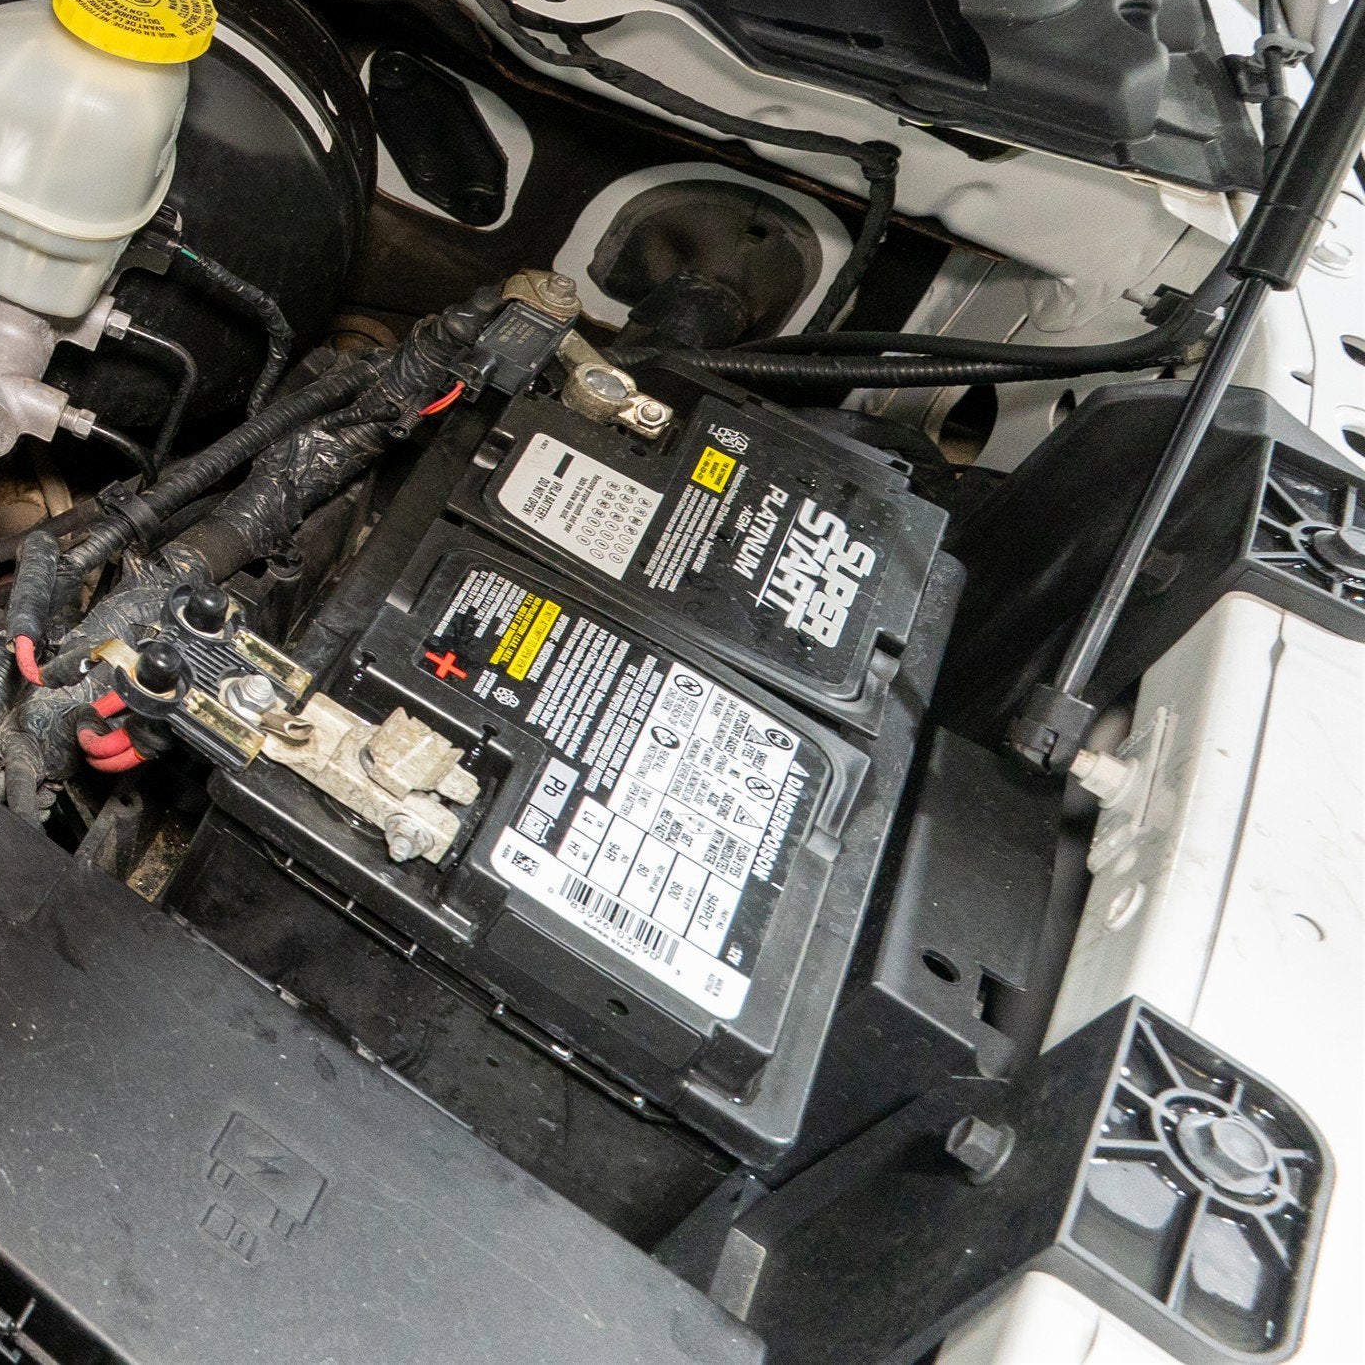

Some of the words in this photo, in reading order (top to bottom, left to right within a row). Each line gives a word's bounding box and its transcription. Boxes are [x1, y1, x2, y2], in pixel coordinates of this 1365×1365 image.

[109, 8, 147, 23] LIQUIDE
[536, 476, 550, 488] DO
[547, 480, 563, 497] VRLA
[577, 476, 588, 487] tabs
[586, 473, 602, 492] Remove
[530, 484, 545, 499] NOT
[569, 489, 581, 501] show
[578, 488, 592, 504] proper
[520, 495, 538, 517] OPEN!
[533, 493, 555, 522] BATTERY
[564, 499, 575, 511] date
[572, 502, 587, 517] month
[558, 508, 570, 521] sold.
[568, 514, 579, 524] and
[733, 504, 755, 533] AGM
[561, 521, 573, 533] year
[729, 481, 790, 580] PLATINUM
[754, 496, 851, 634] START
[794, 530, 880, 651] SUPER
[675, 693, 688, 706] THE
[684, 698, 699, 712] KEEP
[716, 693, 726, 702] OR
[668, 702, 685, 720] REACH
[680, 709, 694, 721] OUT
[720, 708, 734, 724] CAUSE
[677, 718, 690, 729] OF
[729, 708, 750, 739] EXPLOSIVE
[722, 735, 740, 755] GASES
[656, 748, 670, 762] READ
[750, 749, 768, 770] SHIELD
[650, 760, 664, 773] ALL
[727, 768, 741, 779] NO
[541, 774, 569, 801] Pb
[683, 769, 701, 796] BLINDNESS
[698, 779, 711, 790] CAN
[635, 795, 649, 808] NOT
[639, 788, 652, 798] DO
[691, 787, 707, 806] CAUSE
[706, 791, 720, 807] ACID
[715, 792, 735, 820] SULFURIC
[580, 810, 596, 824] L4
[658, 807, 673, 824] HELP
[664, 819, 684, 846] MEDICAL
[750, 773, 803, 882] DANGER/POISON
[678, 832, 694, 847] GET
[709, 828, 725, 845] WITH
[563, 838, 582, 857] H7
[601, 840, 622, 863] 94R
[713, 835, 738, 876] IMMEDIATELY
[734, 843, 751, 862] FLUSH
[635, 863, 650, 877] 80
[727, 859, 744, 878] EYES
[666, 880, 684, 900] 800
[694, 891, 720, 930] 94RPLT
[567, 899, 613, 931] 83996
[613, 929, 660, 961] 03290
[581, 919, 609, 938] SUPER
[609, 937, 635, 956] START
[724, 946, 744, 966] 12V
